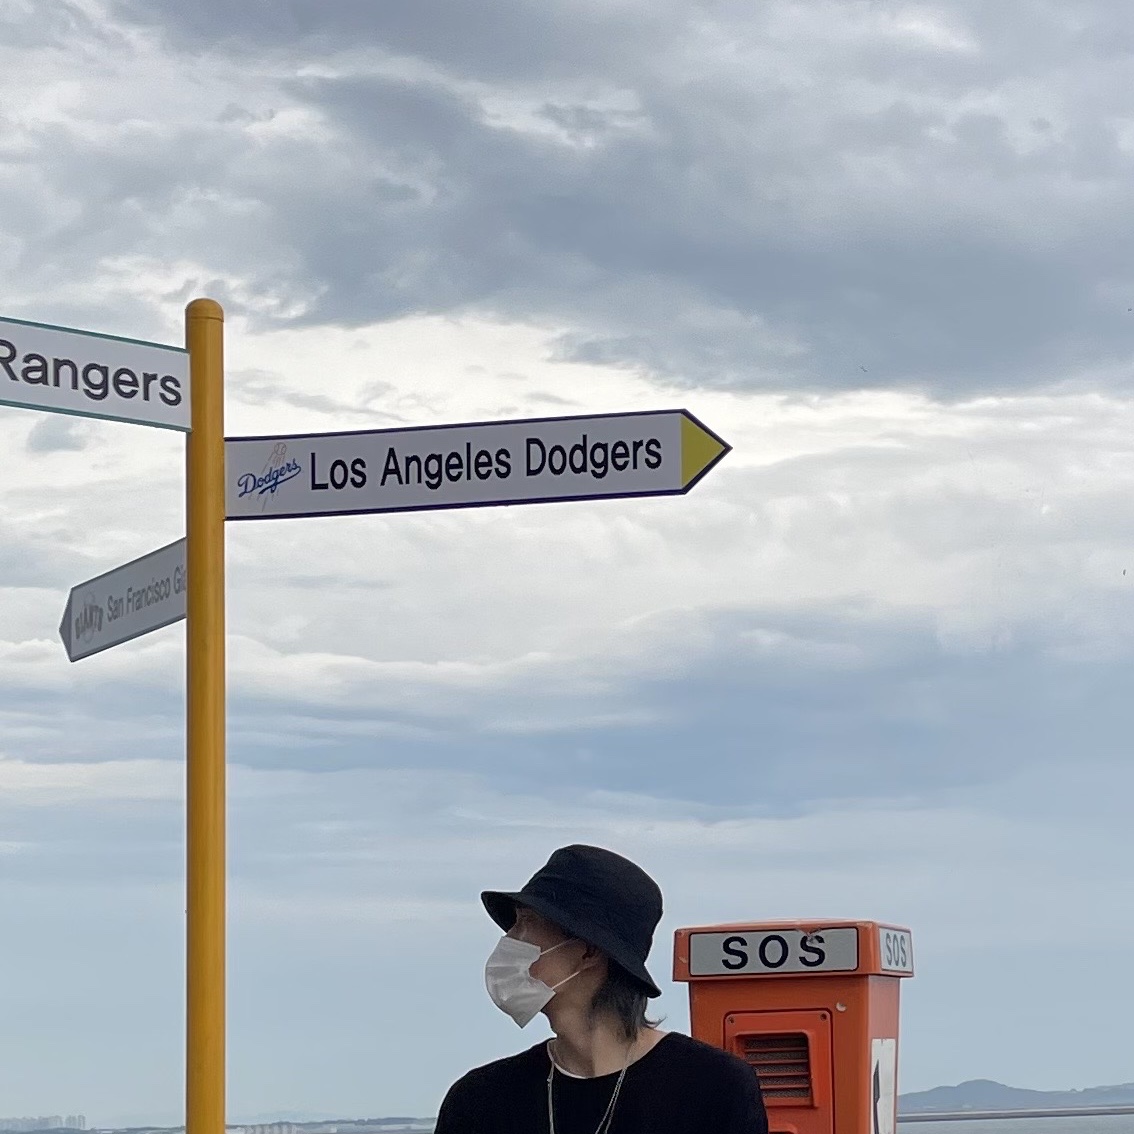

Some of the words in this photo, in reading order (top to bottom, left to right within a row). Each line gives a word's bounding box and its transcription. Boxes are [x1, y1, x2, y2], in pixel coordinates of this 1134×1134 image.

[0, 338, 183, 406] Rangers
[237, 457, 302, 498] Dodgers
[309, 452, 368, 491] Los
[379, 441, 513, 490] Angeles
[525, 434, 663, 480] Dodgers
[106, 595, 125, 622] San
[126, 577, 171, 615] Francisco
[721, 934, 827, 971] SOS
[885, 932, 907, 968] SOS
